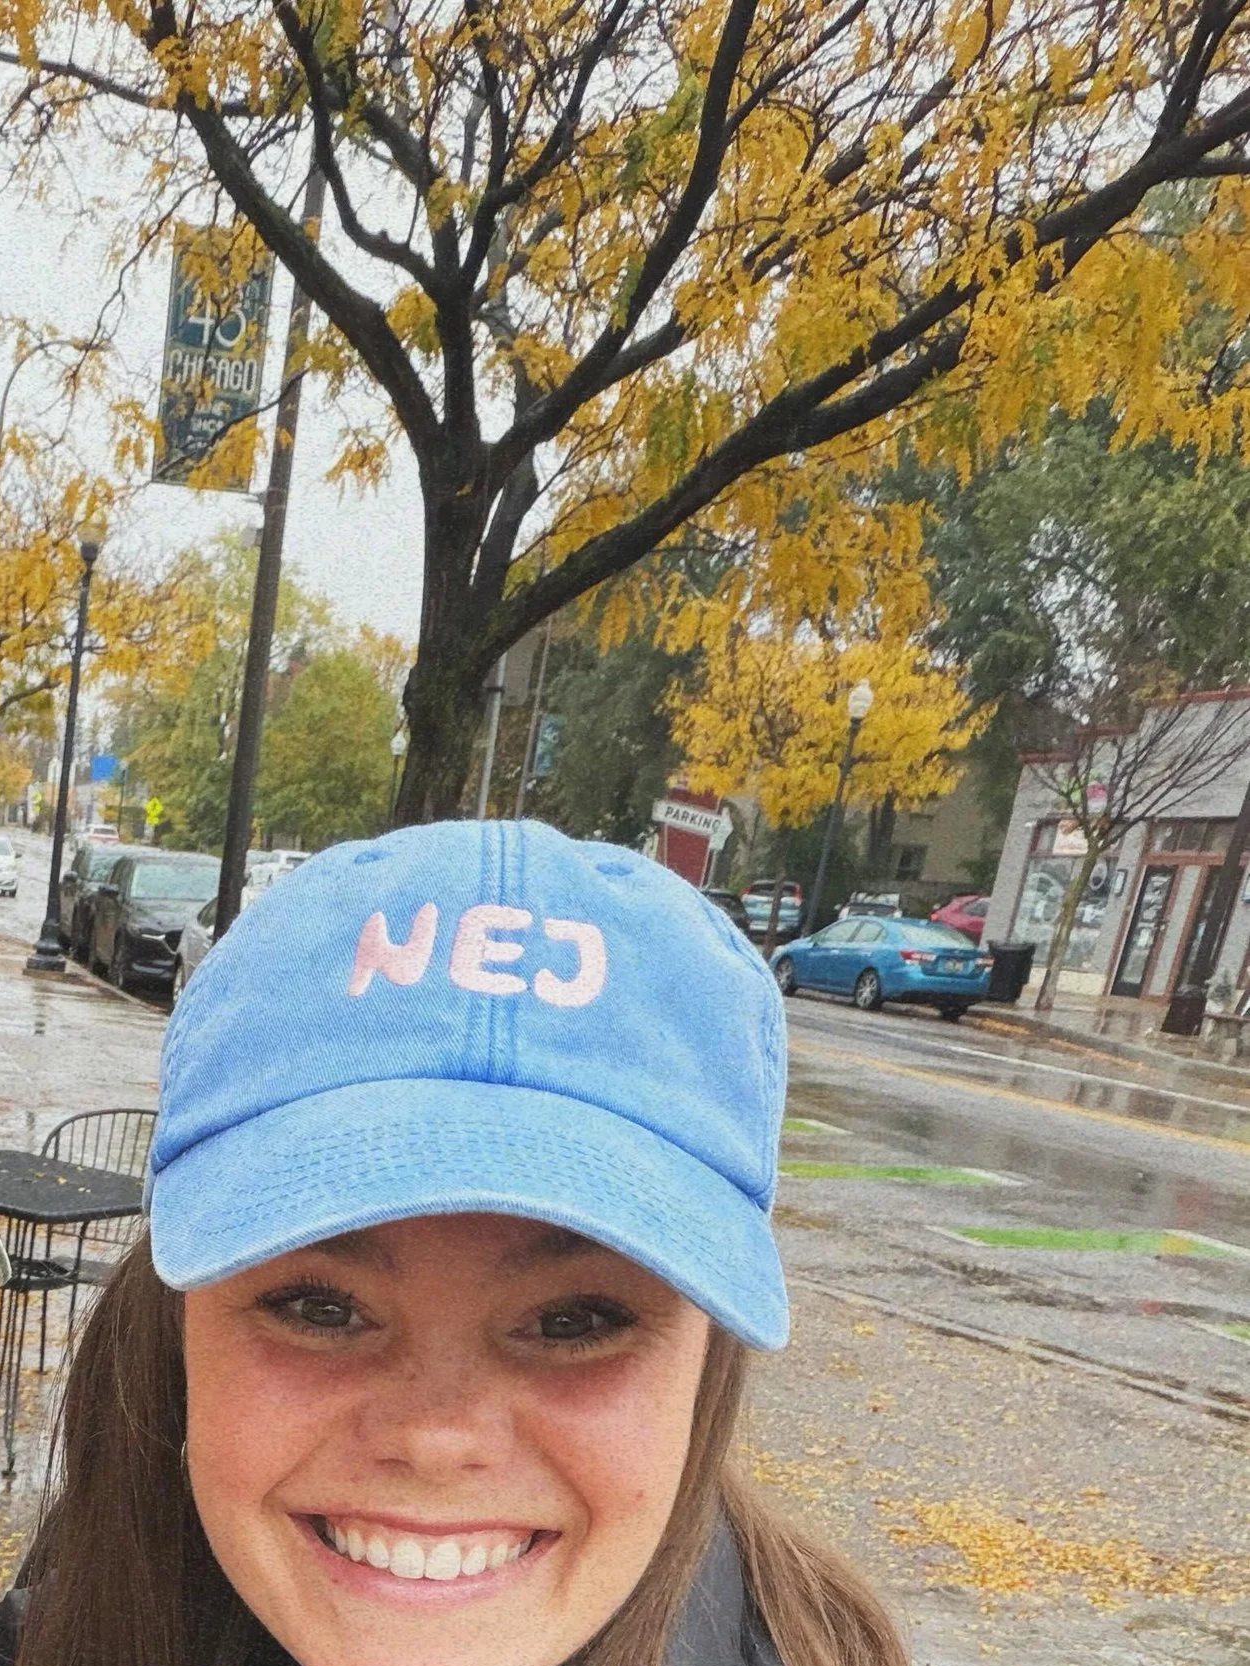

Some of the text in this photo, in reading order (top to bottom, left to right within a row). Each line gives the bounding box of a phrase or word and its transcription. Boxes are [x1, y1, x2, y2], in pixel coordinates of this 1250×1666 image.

[168, 348, 258, 394] CHICAGO
[664, 805, 722, 833] PARKING
[347, 902, 608, 1008] NEJ
